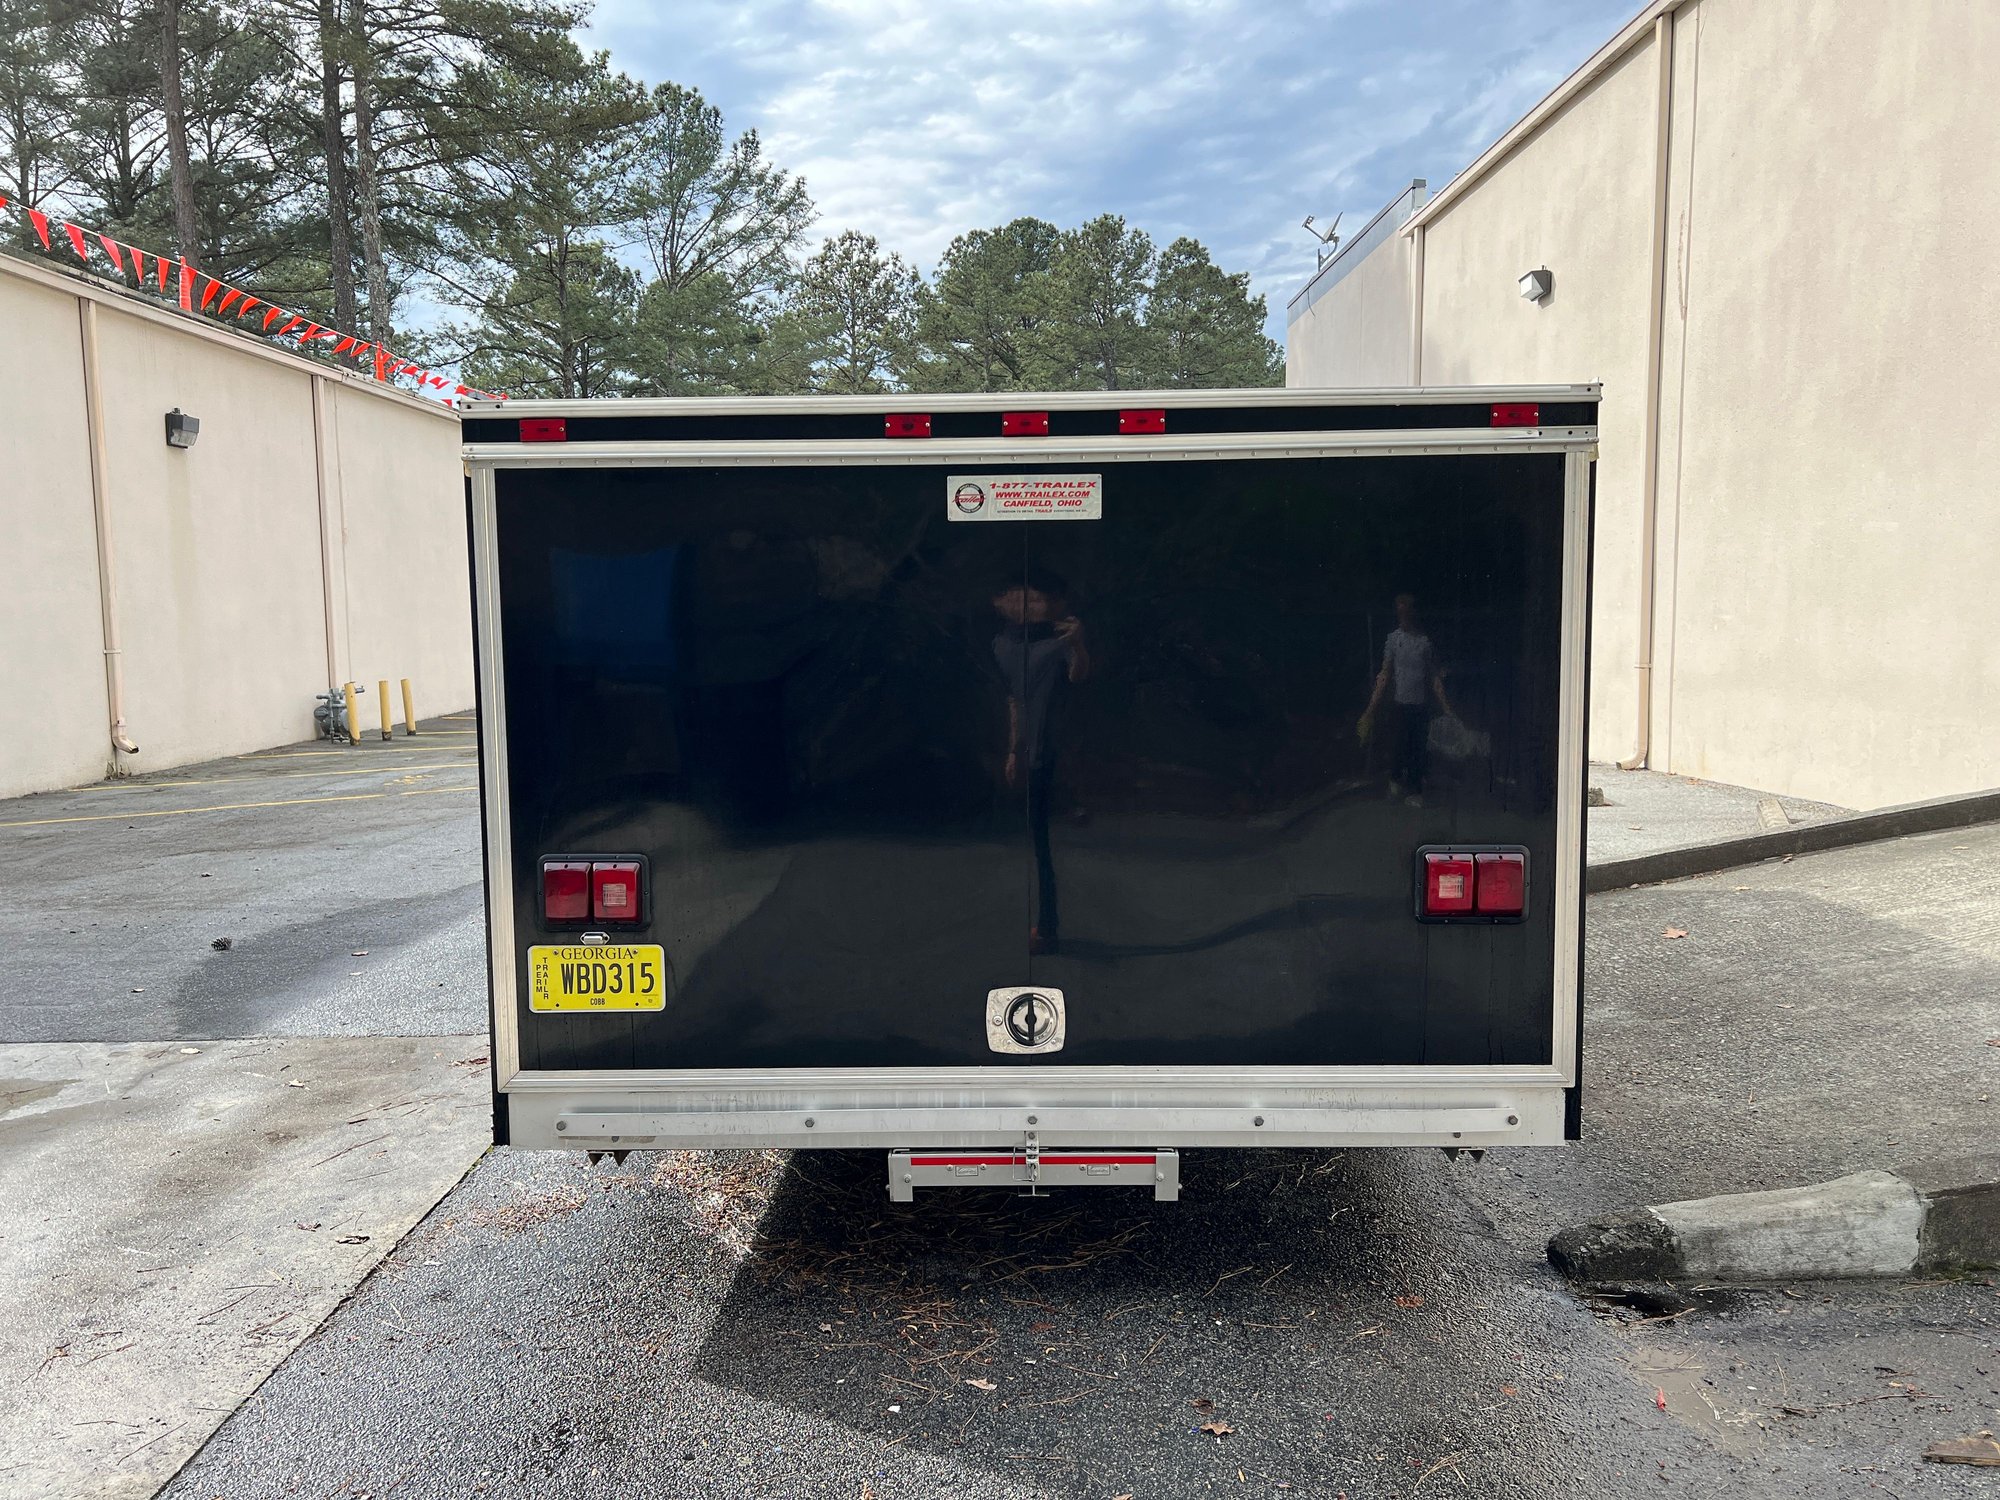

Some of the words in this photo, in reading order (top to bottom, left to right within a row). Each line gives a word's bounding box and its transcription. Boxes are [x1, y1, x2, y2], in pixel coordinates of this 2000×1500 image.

[989, 481, 1097, 490] 1-877-TRAILEX
[994, 490, 1091, 499] WWW.TRAILEX.COM
[1003, 499, 1053, 508] CANFIELD,
[1057, 499, 1083, 507] OHIO
[561, 947, 635, 960] GEORGIA
[560, 962, 655, 995] WBD315
[590, 997, 606, 1006] COBB
